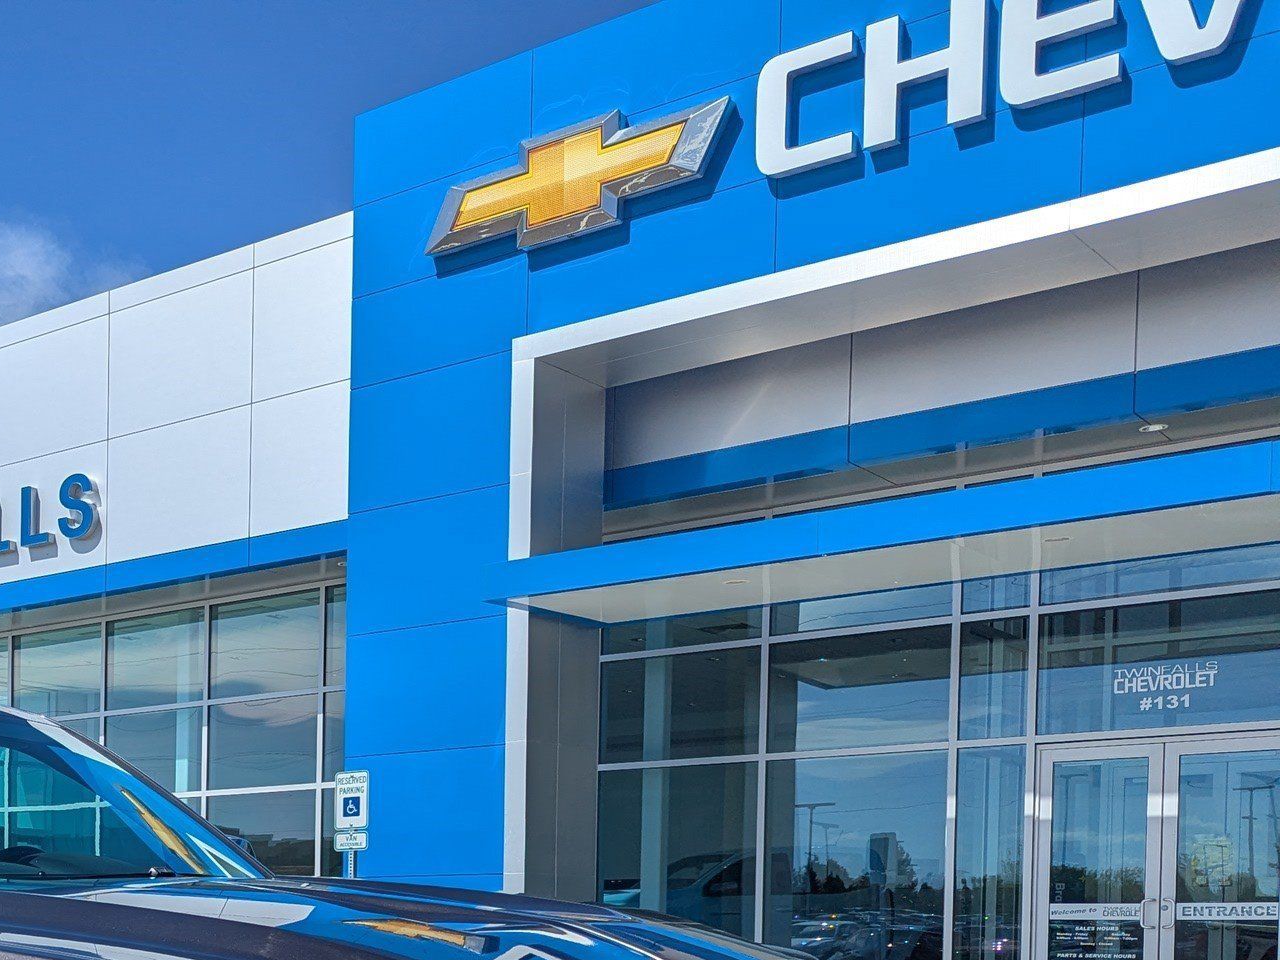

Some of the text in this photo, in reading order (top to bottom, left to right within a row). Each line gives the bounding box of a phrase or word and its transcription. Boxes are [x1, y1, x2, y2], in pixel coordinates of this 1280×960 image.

[1113, 670, 1219, 694] CHEVROLET
[1139, 694, 1191, 711] #131
[337, 775, 366, 785] RESERVED
[339, 786, 365, 795] PARKING
[1051, 908, 1087, 916] Welcome
[1182, 905, 1277, 917] ENTRANCE
